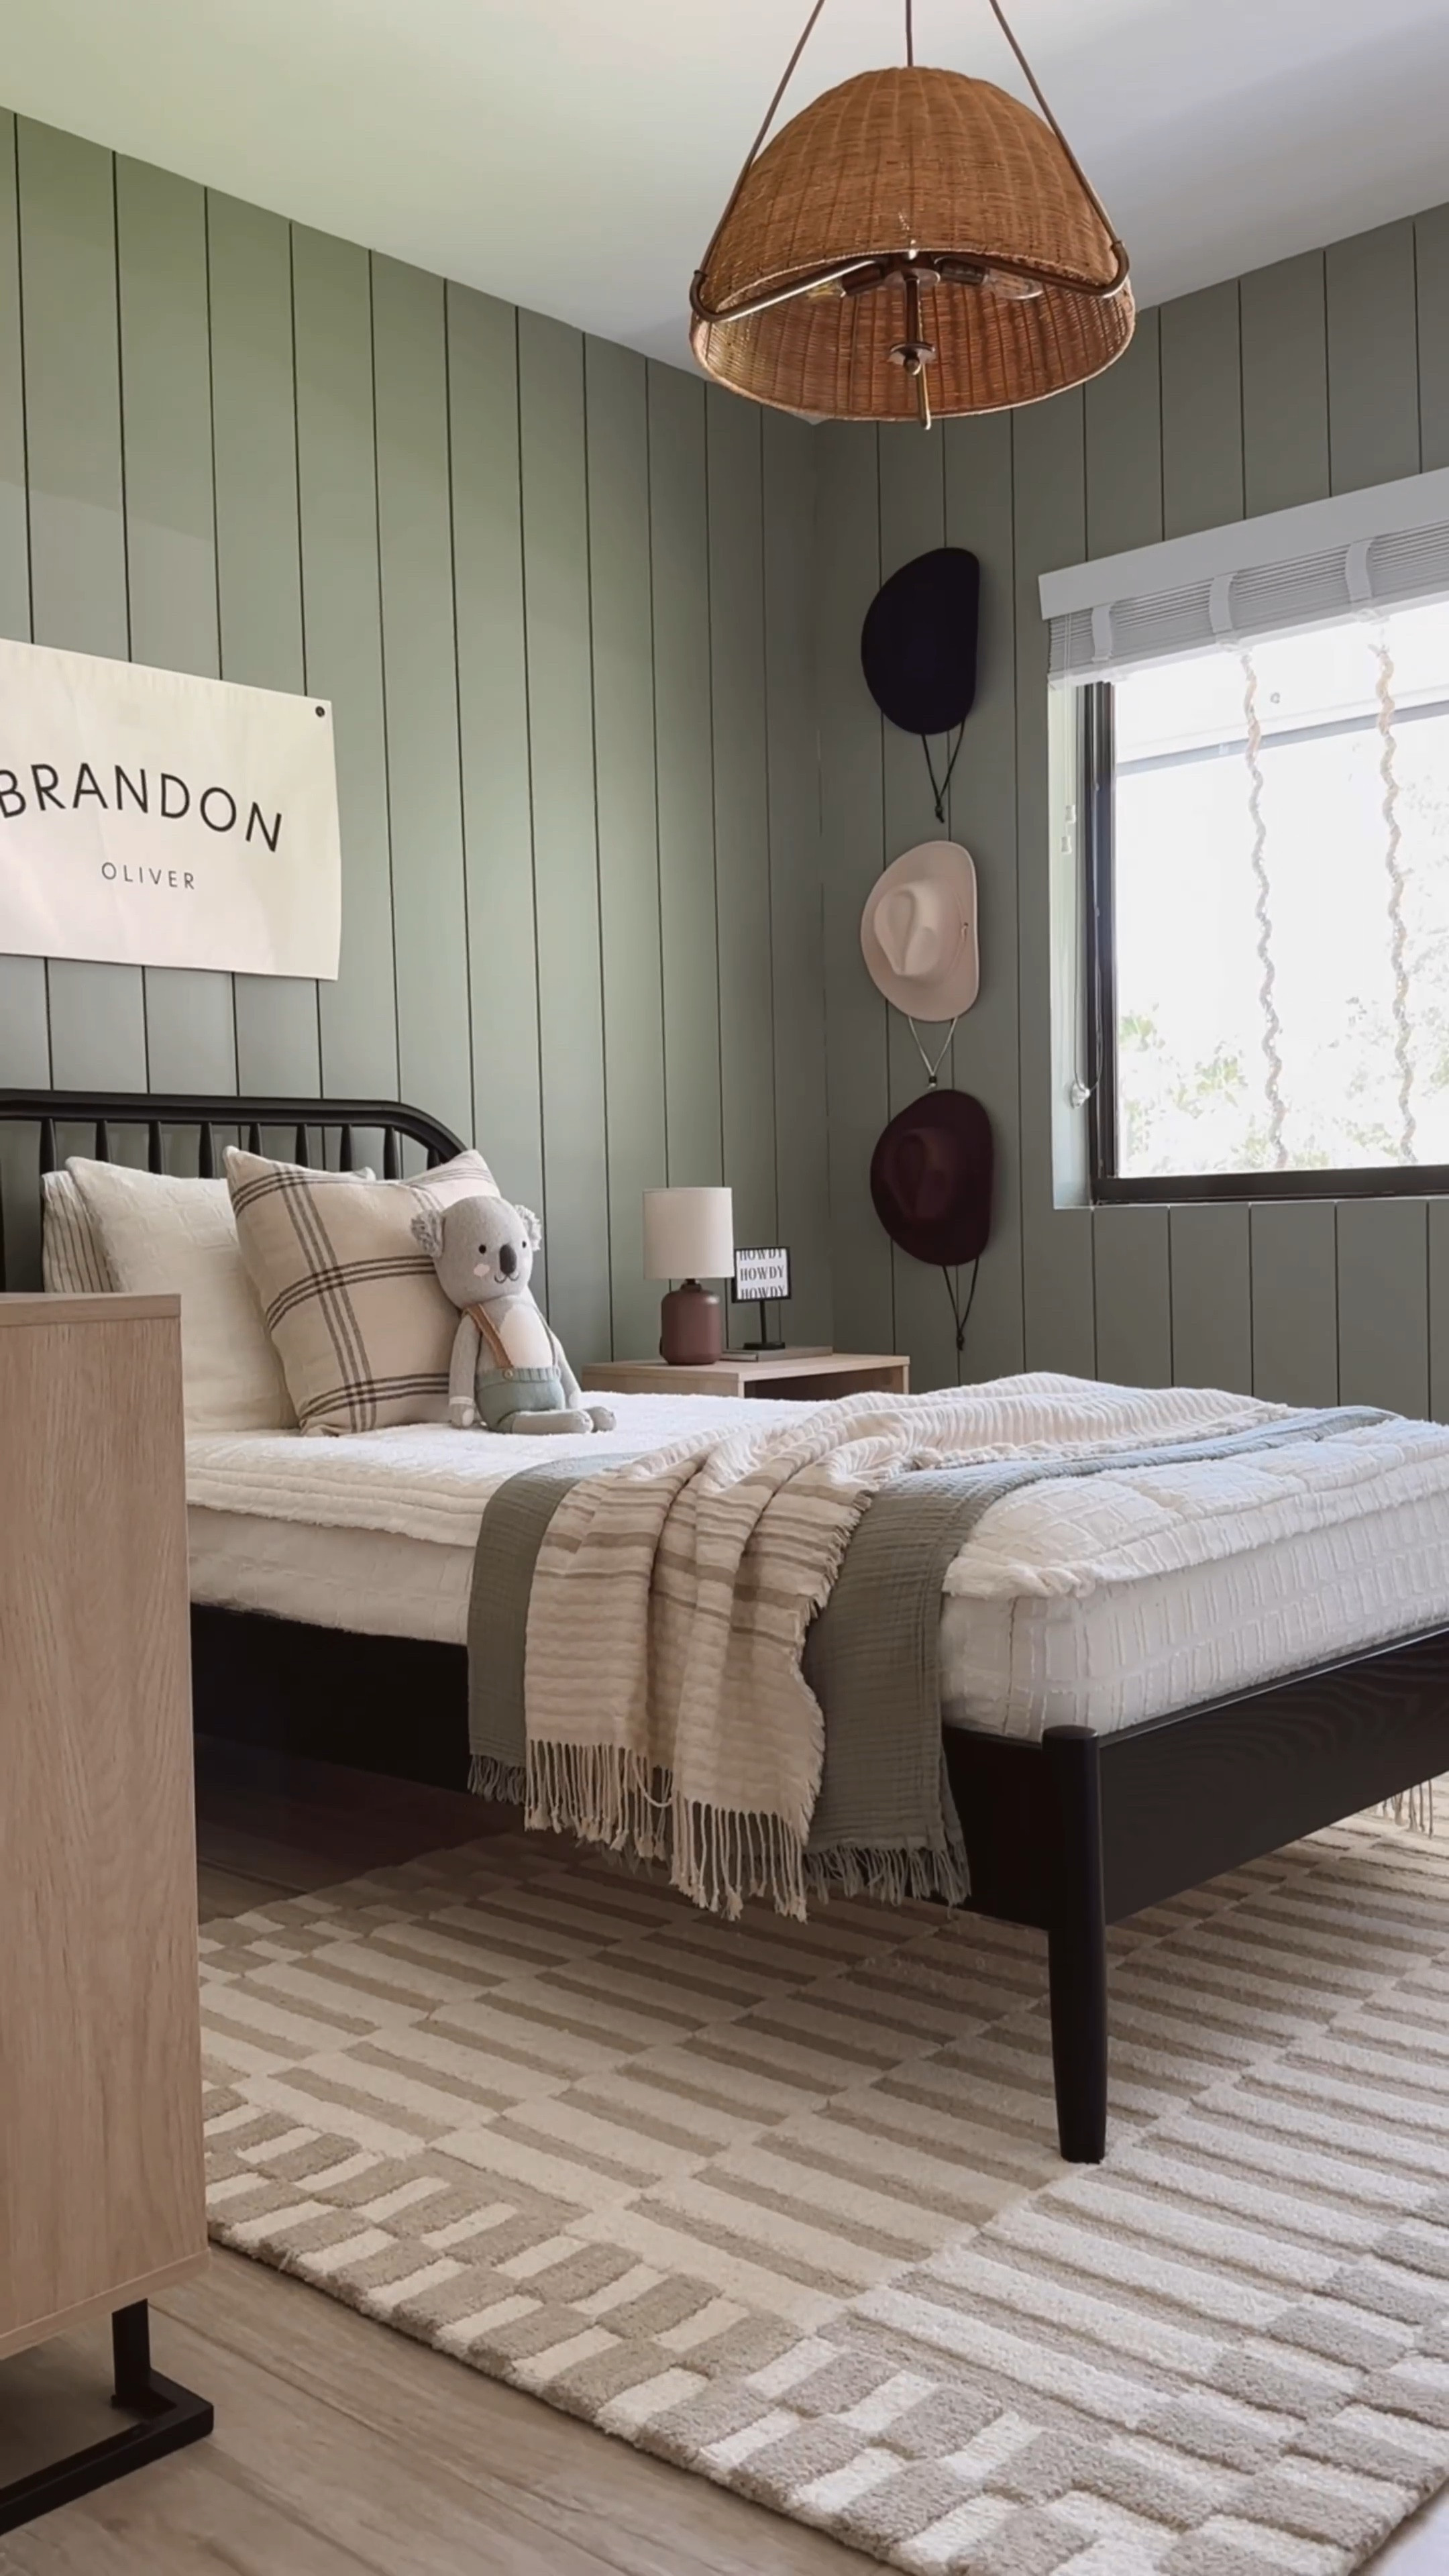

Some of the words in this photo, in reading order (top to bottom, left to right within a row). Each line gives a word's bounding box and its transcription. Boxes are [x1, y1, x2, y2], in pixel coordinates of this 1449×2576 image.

[0, 763, 282, 853] BRANDON
[101, 861, 195, 890] OLIVER
[740, 1265, 784, 1281] HOWDY
[741, 1285, 785, 1299] HOWDY
